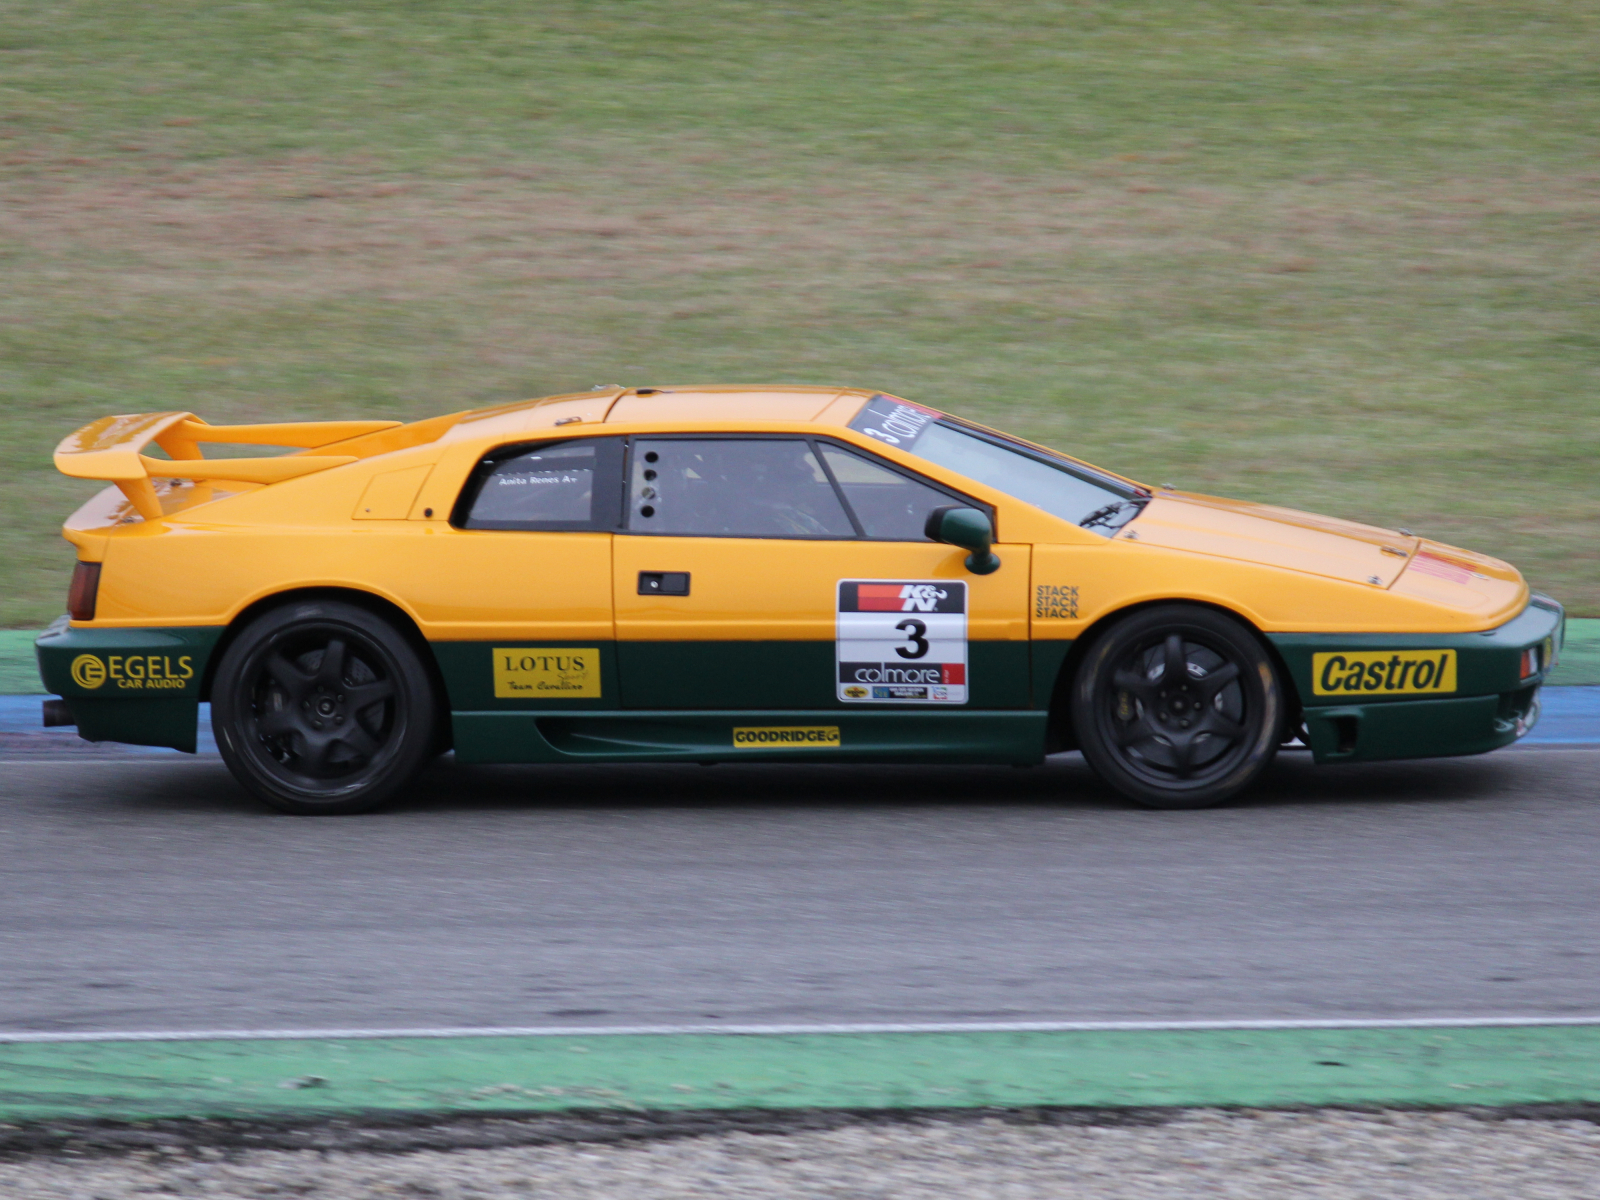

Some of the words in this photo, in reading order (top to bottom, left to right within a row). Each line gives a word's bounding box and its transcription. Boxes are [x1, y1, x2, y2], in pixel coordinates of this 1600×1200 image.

[863, 427, 901, 444] 3
[1036, 585, 1079, 596] STACK
[1036, 596, 1079, 607] STACK
[1036, 607, 1078, 619] STACK
[894, 618, 929, 660] 3
[108, 655, 194, 679] EGELS
[504, 656, 585, 672] LOTUS
[854, 662, 941, 684] colmore
[1321, 654, 1449, 692] Castrol
[117, 678, 144, 689] CAR
[145, 679, 186, 689] AUDIO
[508, 681, 533, 690] Team
[735, 730, 827, 743] GOODRIDGE
